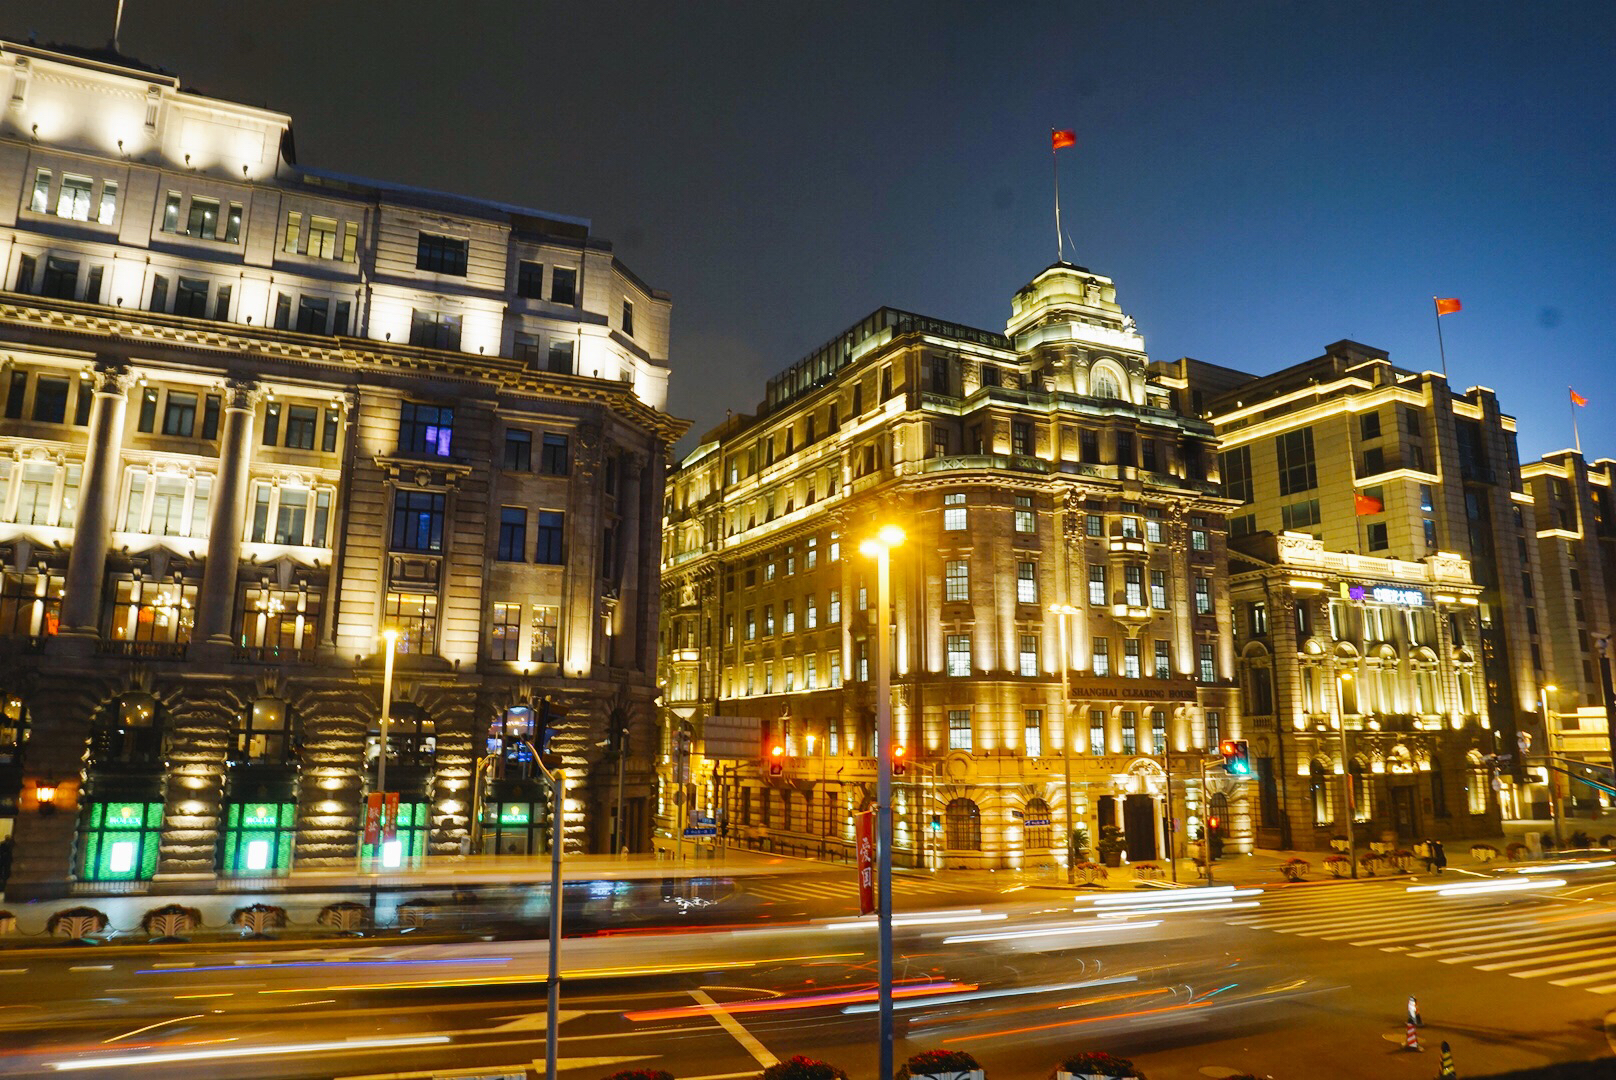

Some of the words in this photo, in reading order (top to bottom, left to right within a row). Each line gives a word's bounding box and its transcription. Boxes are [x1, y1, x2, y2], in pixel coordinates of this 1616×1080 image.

[1072, 687, 1118, 698] SHANGHAI
[1122, 688, 1165, 699] CLEARING
[1169, 690, 1196, 700] HOUSE
[109, 817, 142, 825] ROLEX
[246, 816, 277, 825] ROLEX
